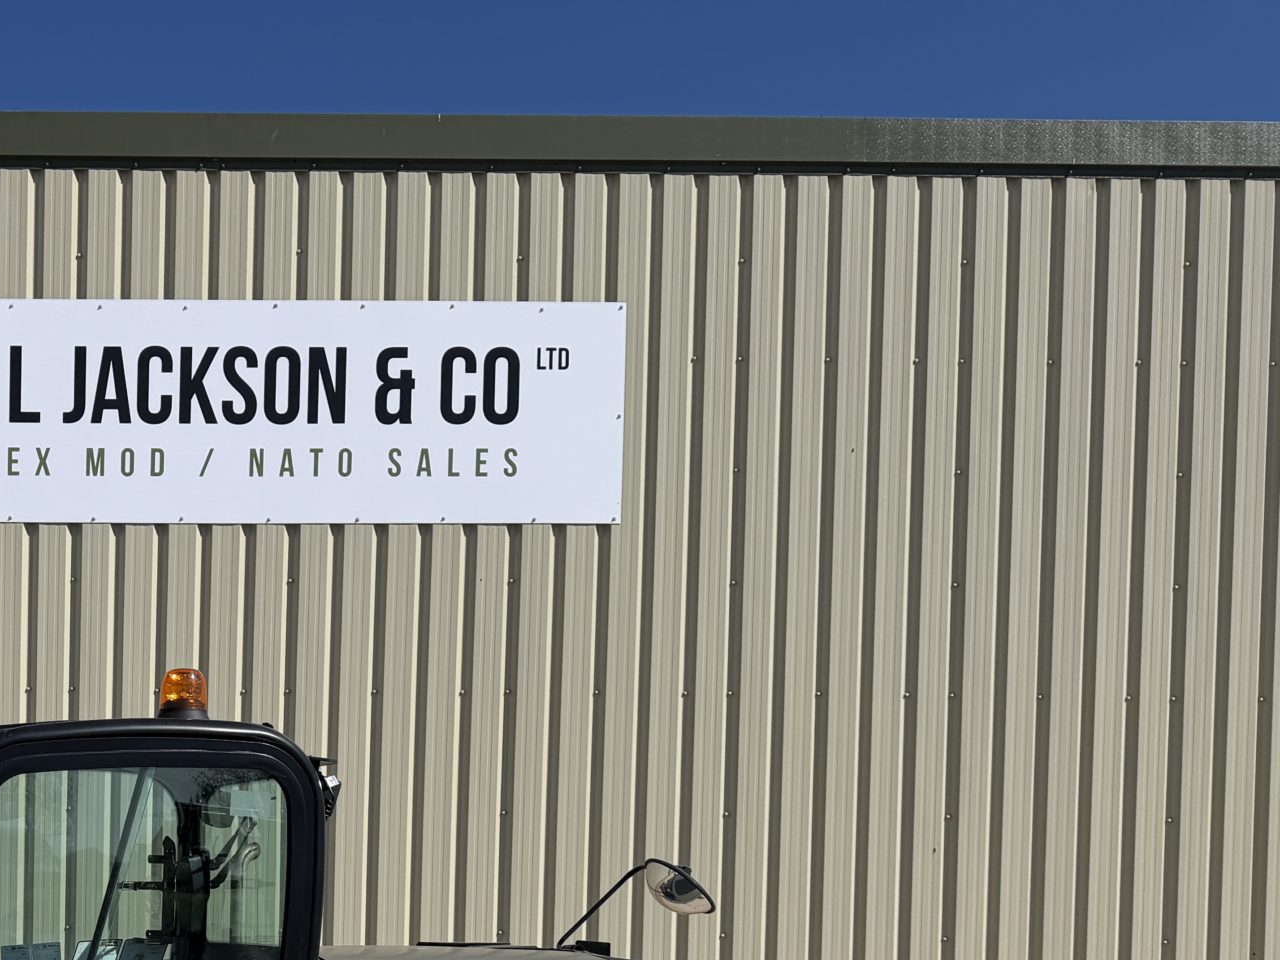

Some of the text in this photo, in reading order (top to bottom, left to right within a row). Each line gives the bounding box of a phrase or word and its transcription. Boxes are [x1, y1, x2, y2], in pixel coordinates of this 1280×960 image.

[8, 345, 570, 426] L JACKSON & CO LTD
[7, 446, 518, 478] EX MOD / NATO SALES
